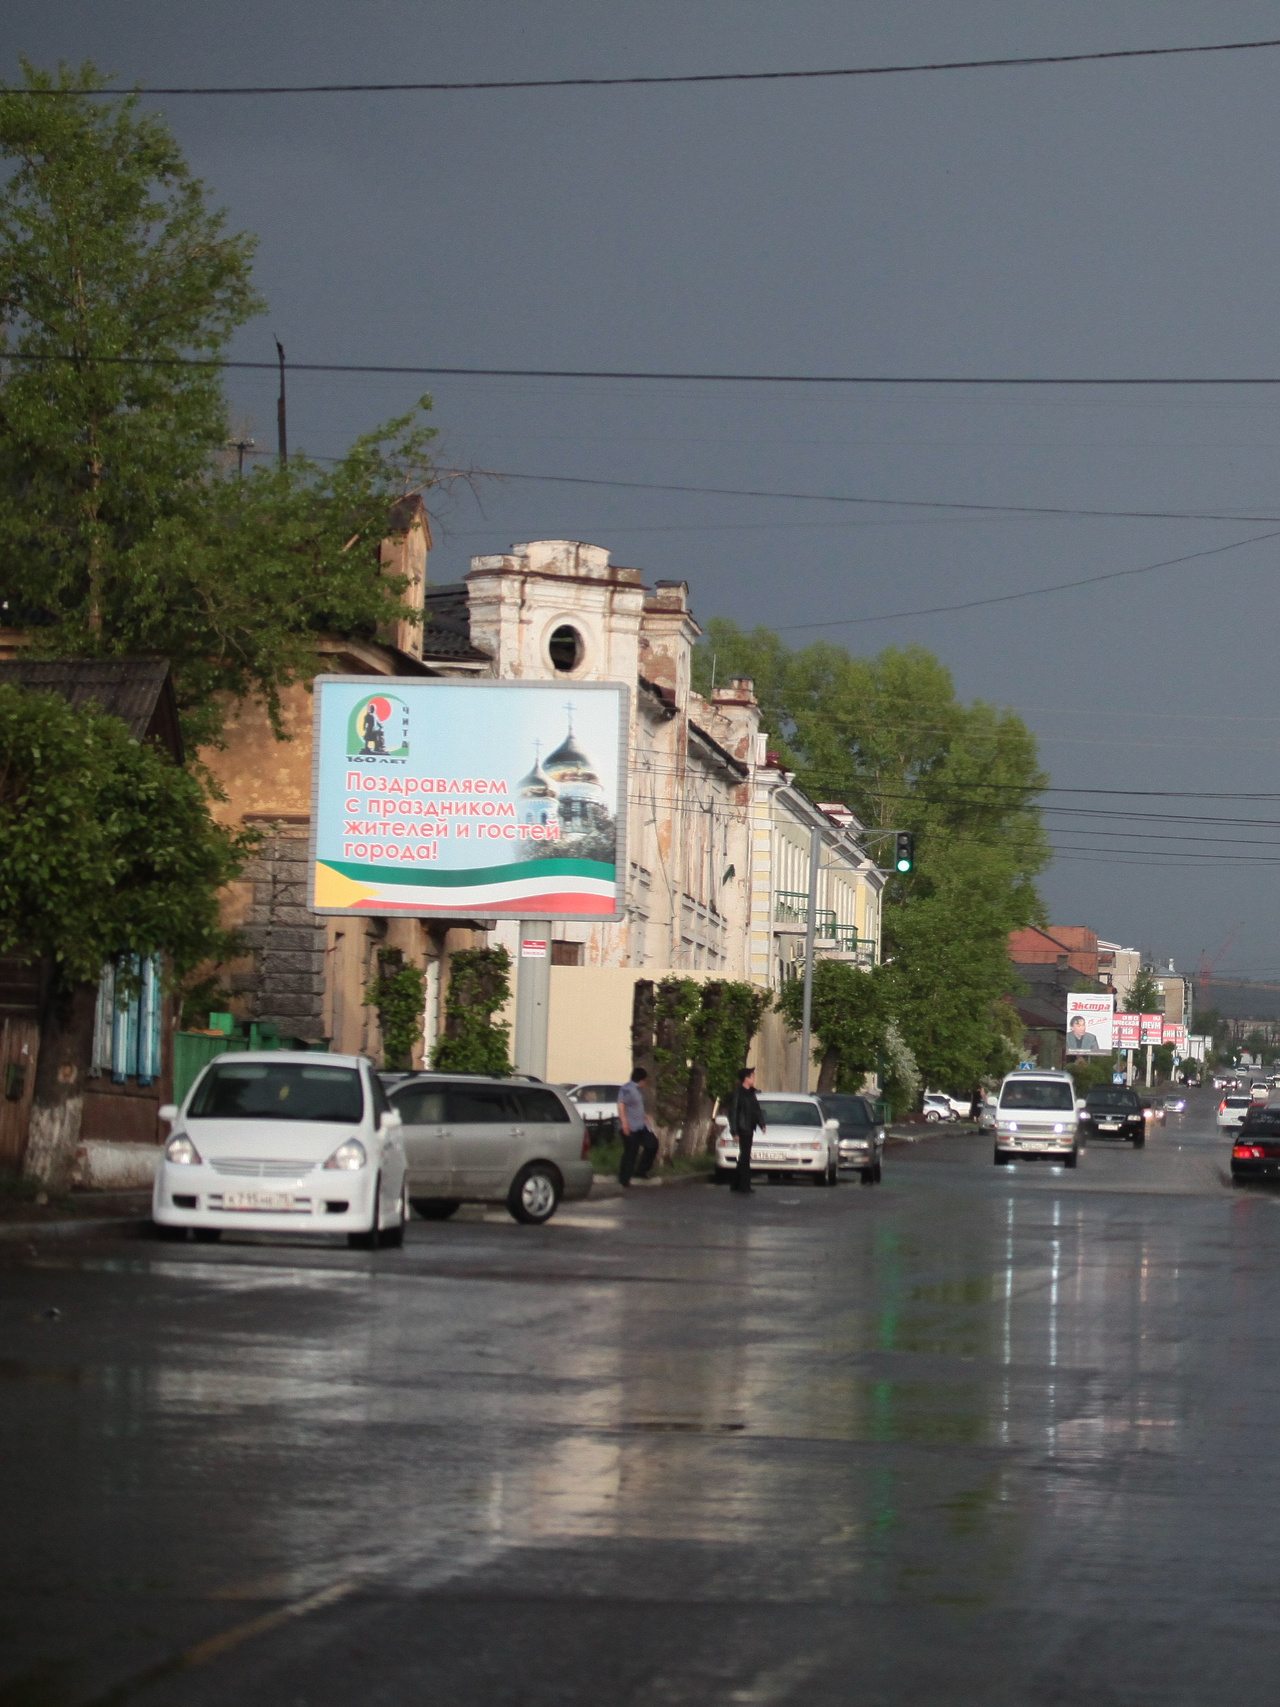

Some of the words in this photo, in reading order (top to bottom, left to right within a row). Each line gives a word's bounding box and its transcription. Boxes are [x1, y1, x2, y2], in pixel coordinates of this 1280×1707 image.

[346, 771, 508, 796] Поздравляем
[345, 798, 360, 813] с
[368, 799, 515, 818] праздником
[344, 818, 448, 837] жителей
[456, 824, 469, 837] и
[477, 819, 560, 840] гостей
[344, 841, 438, 862] города!
[1070, 1002, 1110, 1012] Экстра
